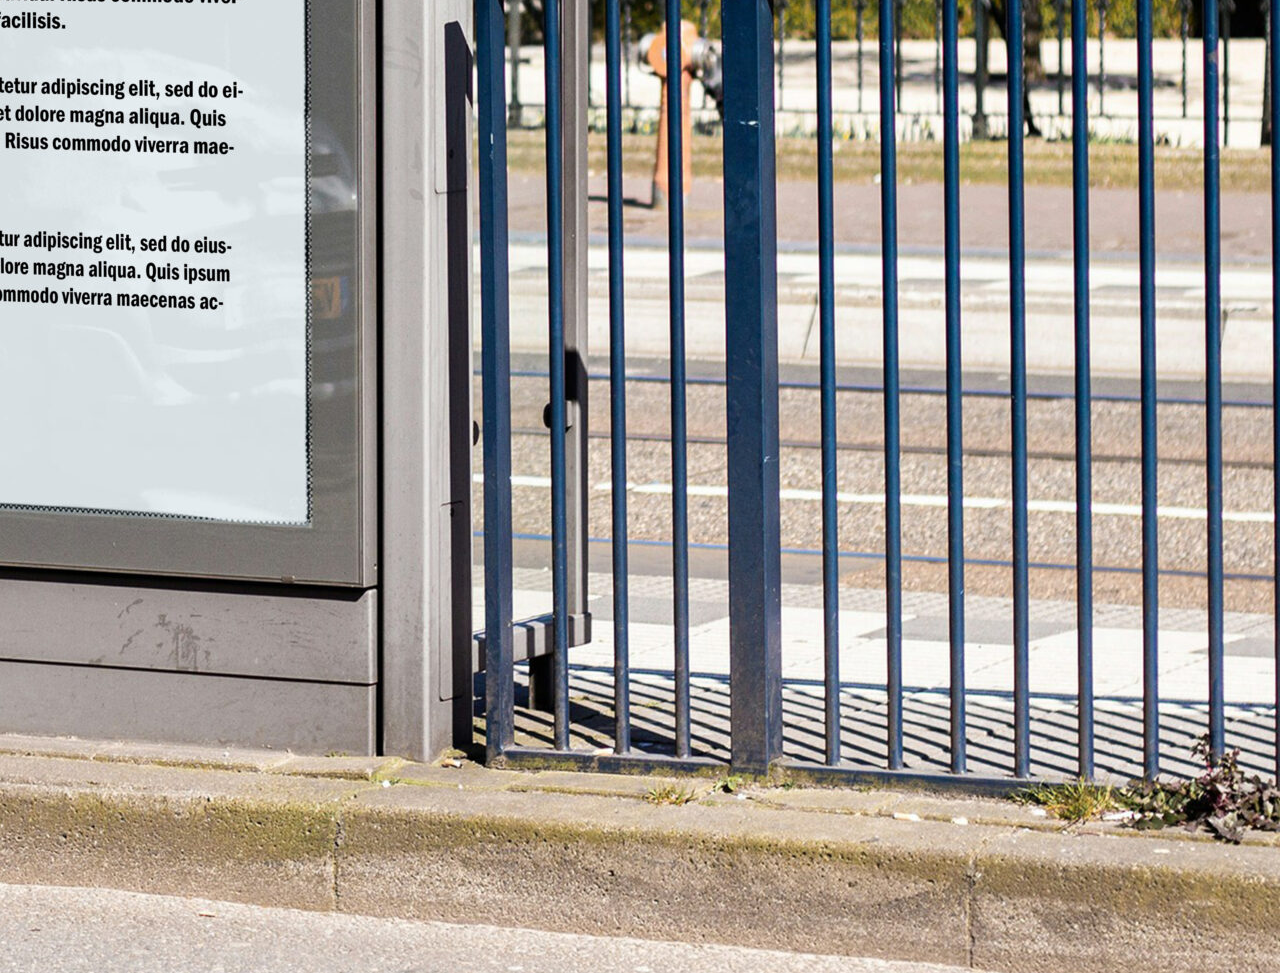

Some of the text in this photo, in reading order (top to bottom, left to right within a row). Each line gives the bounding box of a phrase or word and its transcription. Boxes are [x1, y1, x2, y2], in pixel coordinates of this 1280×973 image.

[40, 77, 126, 100] adipiscing
[128, 79, 160, 101] elit,
[164, 80, 194, 98] sed
[198, 80, 219, 99] do
[222, 81, 244, 99] ei-
[14, 104, 66, 123] dolore
[69, 108, 125, 128] magna
[128, 107, 185, 129] aliqua.
[189, 108, 227, 129] Quis
[5, 131, 49, 150] Risus
[52, 135, 132, 153] commodo
[134, 135, 189, 154] viverra
[193, 140, 235, 155] mae-
[23, 230, 103, 254] adipiscing
[105, 233, 136, 254] elit,
[139, 235, 167, 252] sed
[170, 235, 191, 253] do
[193, 236, 232, 255] eius-
[33, 261, 85, 281] magna
[88, 260, 141, 282] aliqua.
[145, 262, 180, 283] Quis
[183, 263, 231, 285] ipsum
[61, 287, 113, 306] viverra
[116, 293, 196, 310] maecenas
[199, 296, 224, 311] ac-
